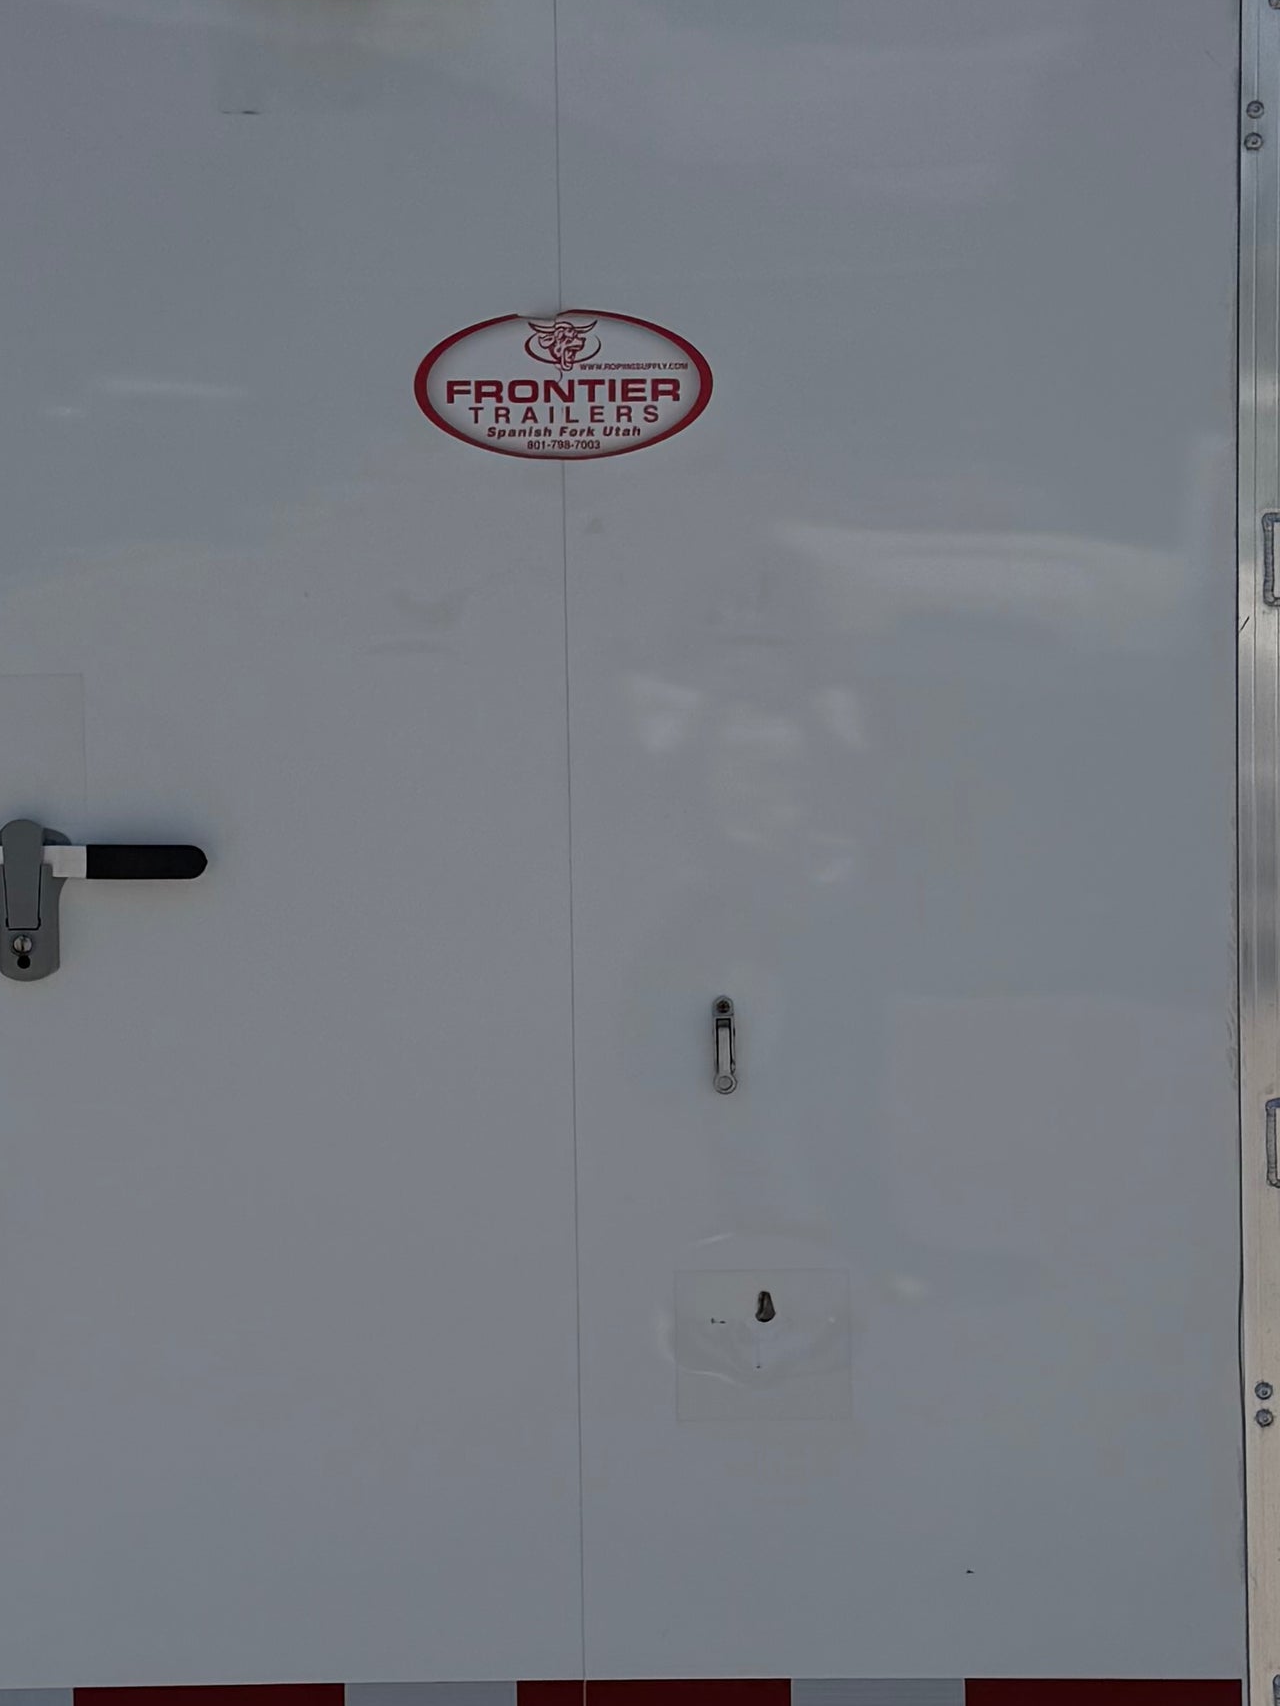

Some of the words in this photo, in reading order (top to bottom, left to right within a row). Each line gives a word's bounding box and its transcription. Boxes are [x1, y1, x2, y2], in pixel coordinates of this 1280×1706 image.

[446, 378, 681, 404] FRONTIER
[469, 405, 660, 424] TRAILERS
[487, 426, 553, 440] Spanish
[559, 426, 596, 437] Fork
[602, 426, 642, 437] Utah
